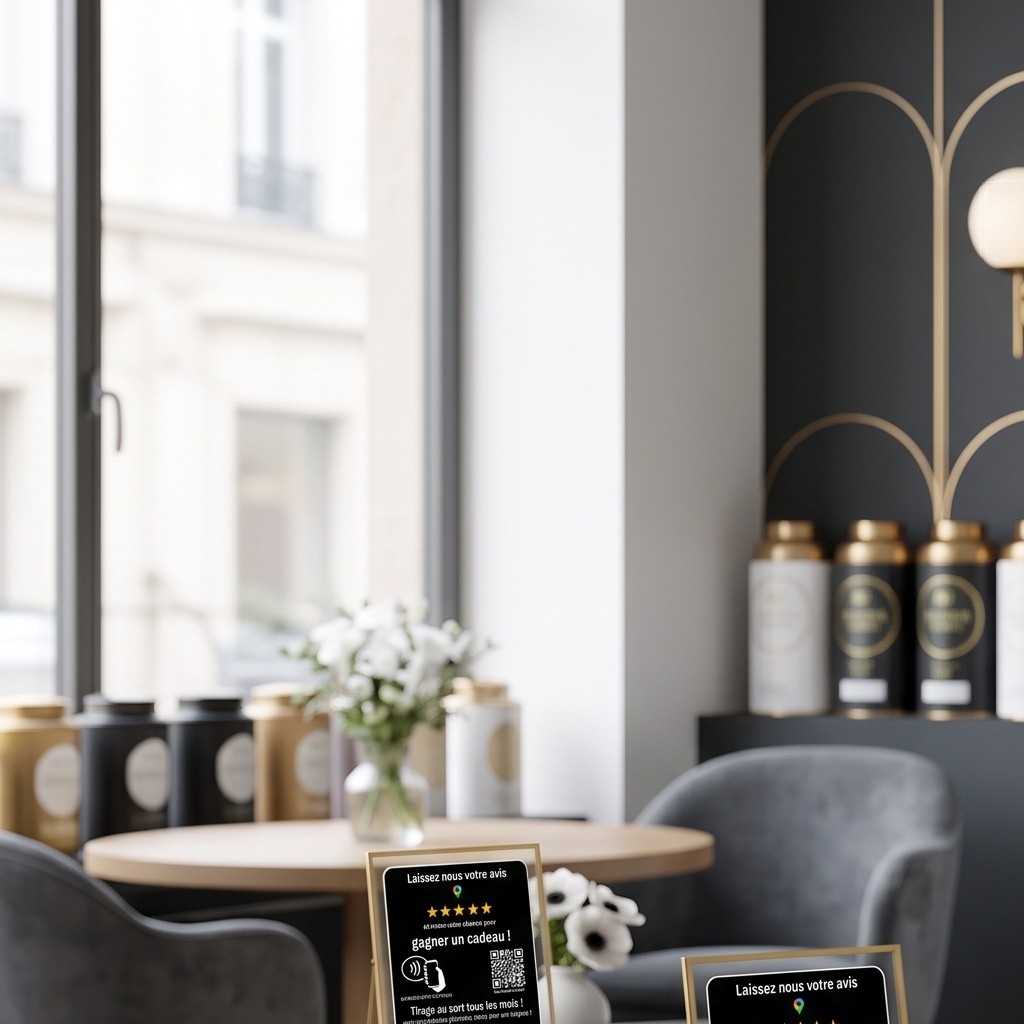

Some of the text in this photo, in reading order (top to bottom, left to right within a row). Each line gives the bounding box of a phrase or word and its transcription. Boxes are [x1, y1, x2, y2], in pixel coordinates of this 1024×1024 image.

[406, 867, 507, 884] Laissez nous votre avis
[411, 929, 511, 952] gagner un cadeau !
[735, 975, 858, 997] Laissez nous votre avis
[409, 1005, 436, 1018] Tirage
[436, 1006, 447, 1015] au
[448, 1002, 465, 1014] sort
[465, 1002, 485, 1012] tous
[485, 1000, 498, 1011] les
[498, 998, 519, 1009] mois
[520, 997, 524, 1008] !
